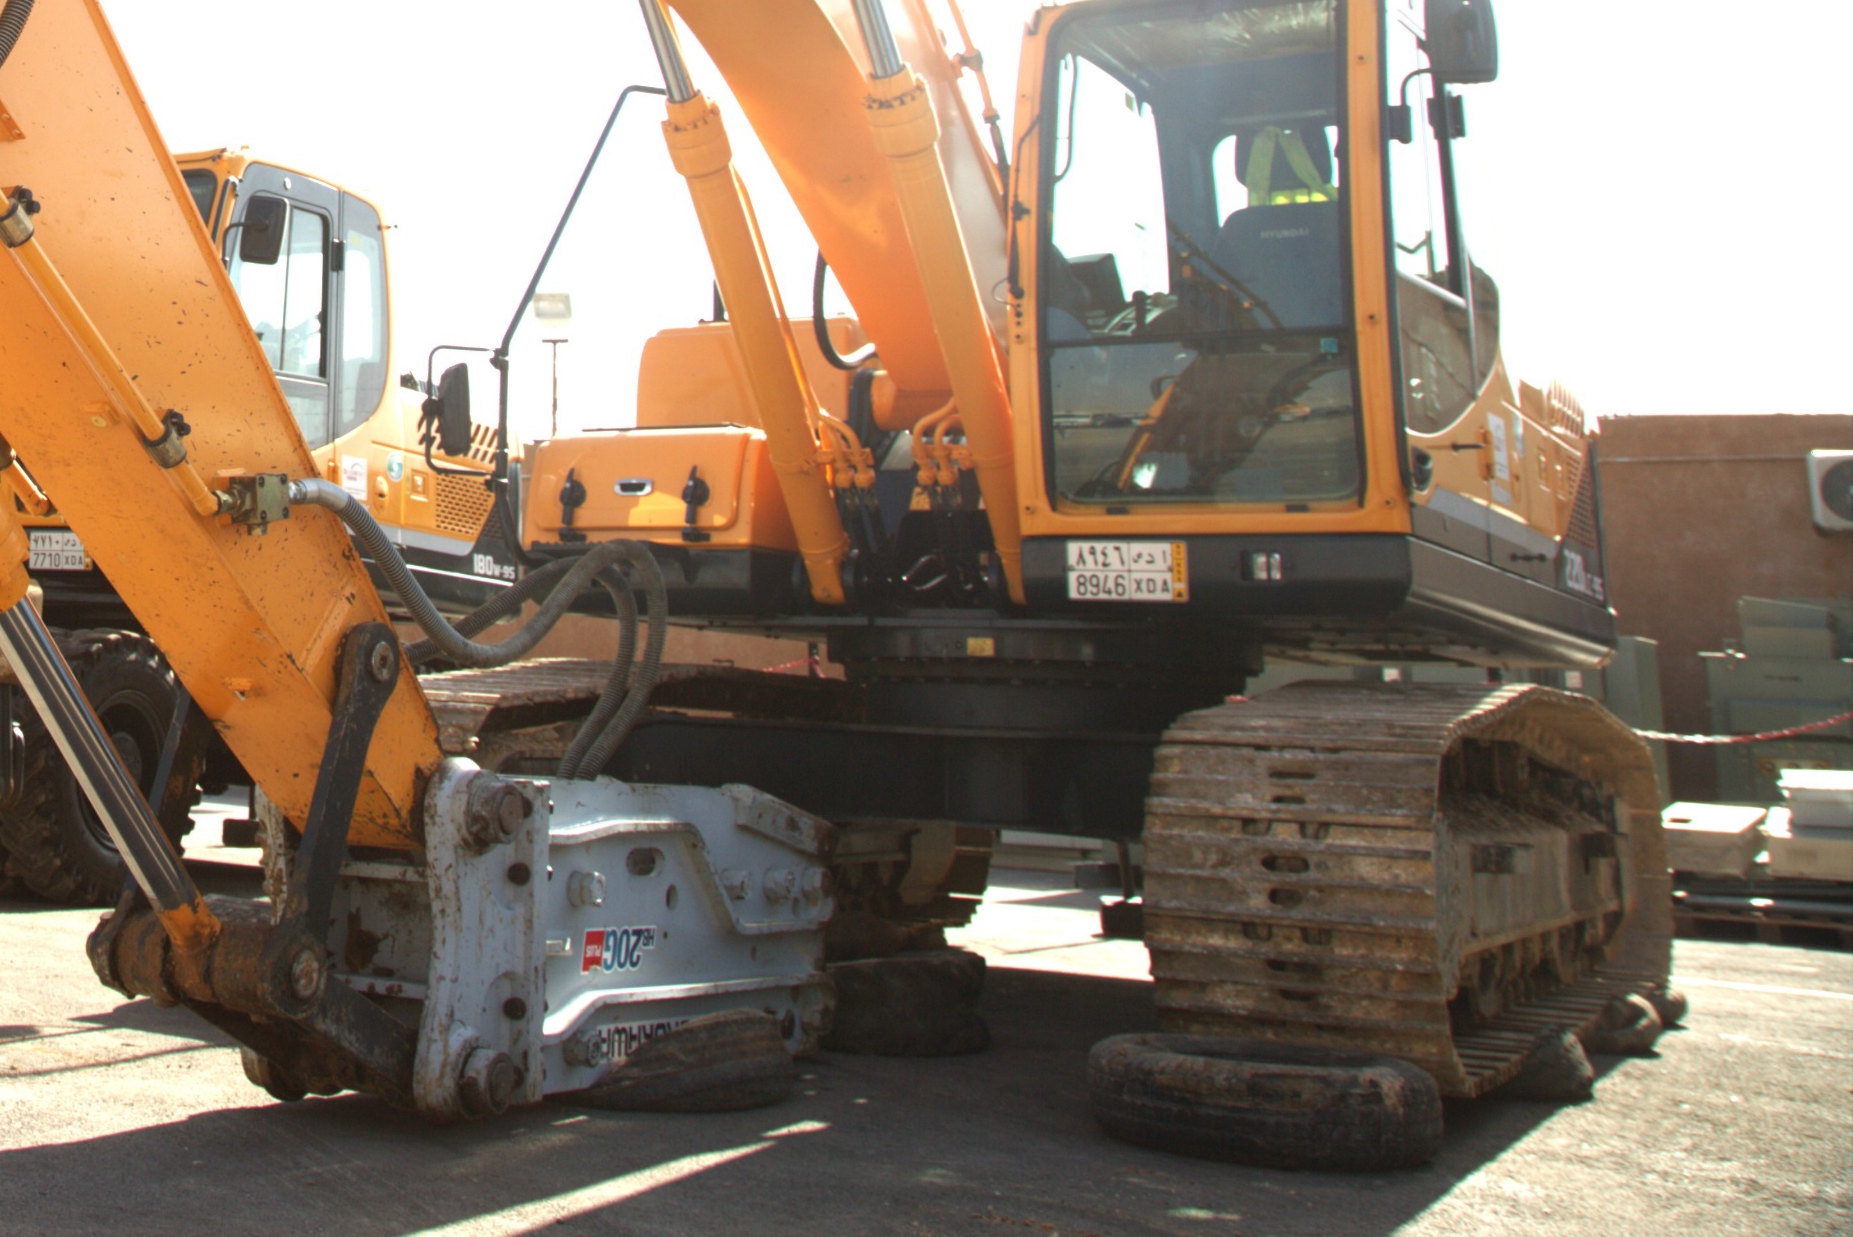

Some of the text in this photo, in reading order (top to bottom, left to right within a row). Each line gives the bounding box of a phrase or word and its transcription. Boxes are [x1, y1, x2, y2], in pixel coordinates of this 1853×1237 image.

[33, 552, 61, 568] 7710
[1076, 546, 1125, 568] ٨٩٤٦
[1076, 574, 1170, 597] 8946 XDA
[585, 944, 602, 957] PLUS
